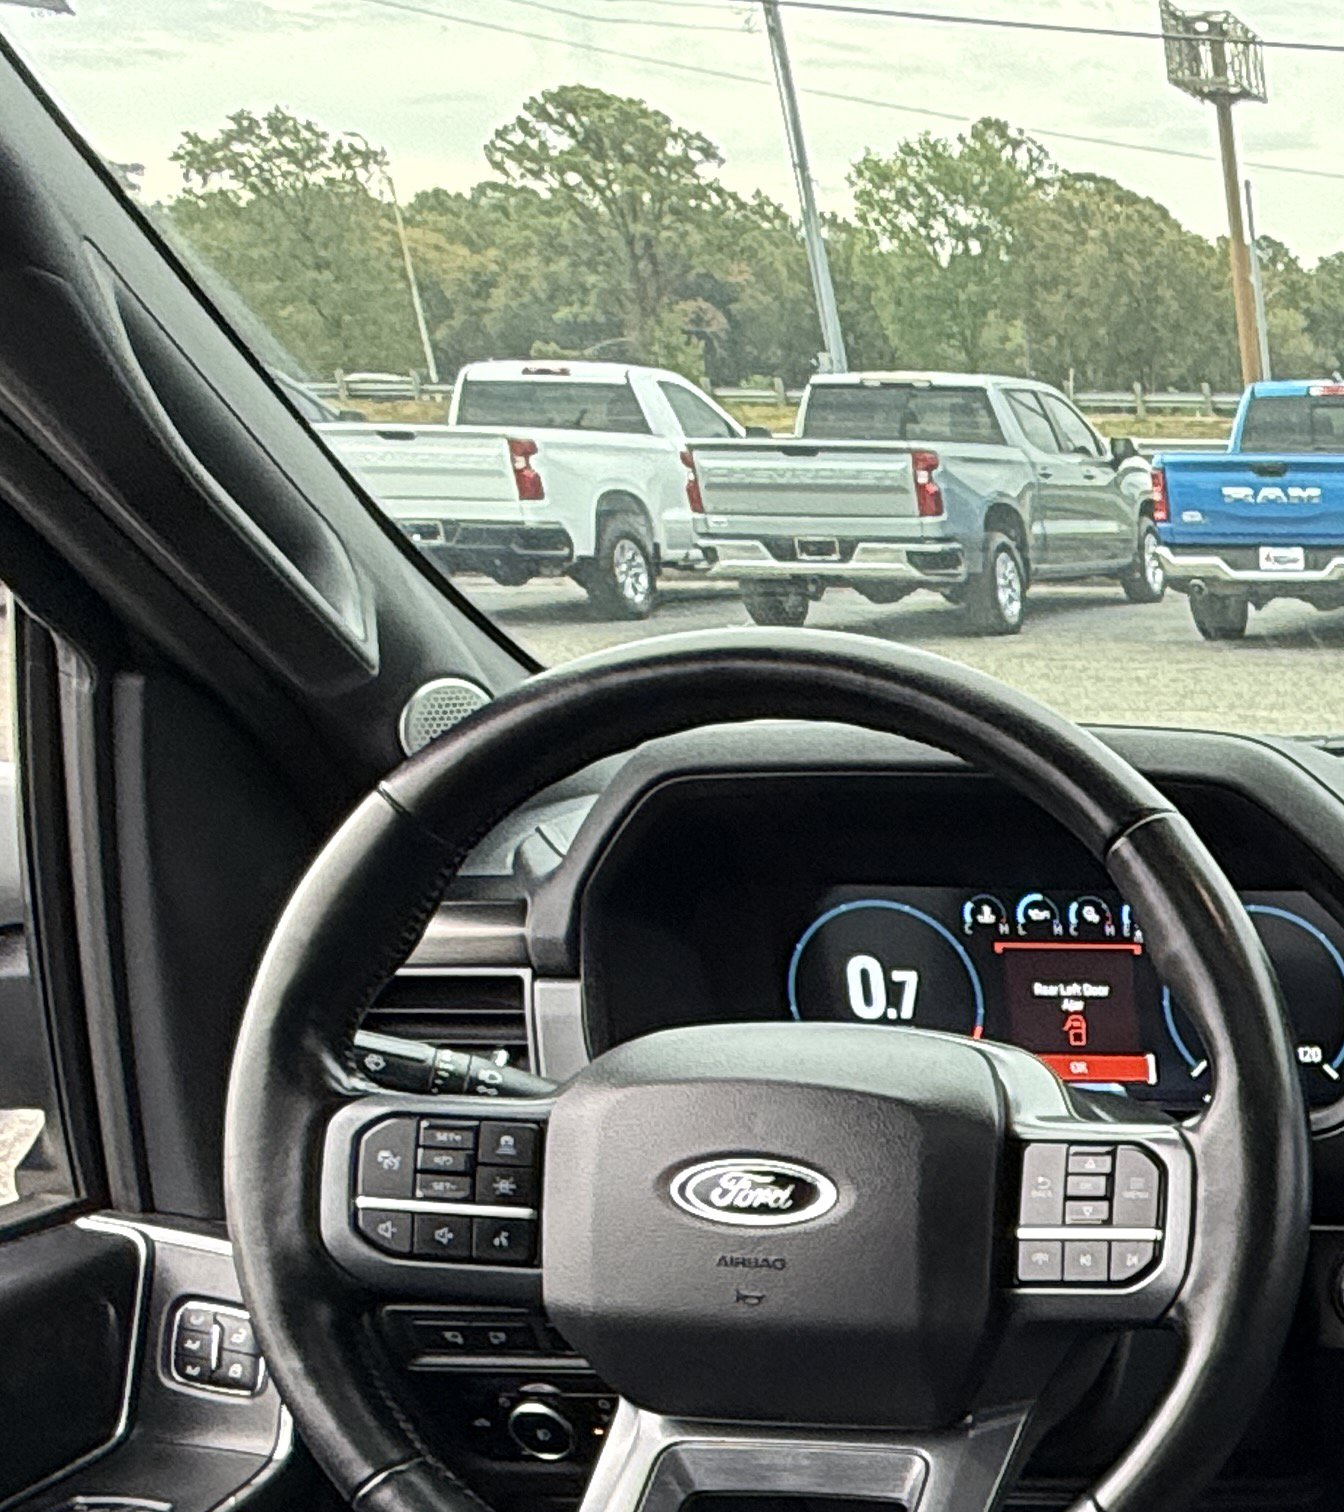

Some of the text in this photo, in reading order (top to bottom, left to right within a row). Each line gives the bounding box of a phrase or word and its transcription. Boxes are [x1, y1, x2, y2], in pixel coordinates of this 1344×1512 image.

[1221, 486, 1322, 504] RAM
[846, 954, 919, 1020] 0.7
[1033, 982, 1110, 997] Rear Left Door
[1298, 1046, 1323, 1063] 120
[1069, 1061, 1088, 1074] OK
[711, 1170, 796, 1209] Ford
[716, 1254, 787, 1271] AIRBAG
